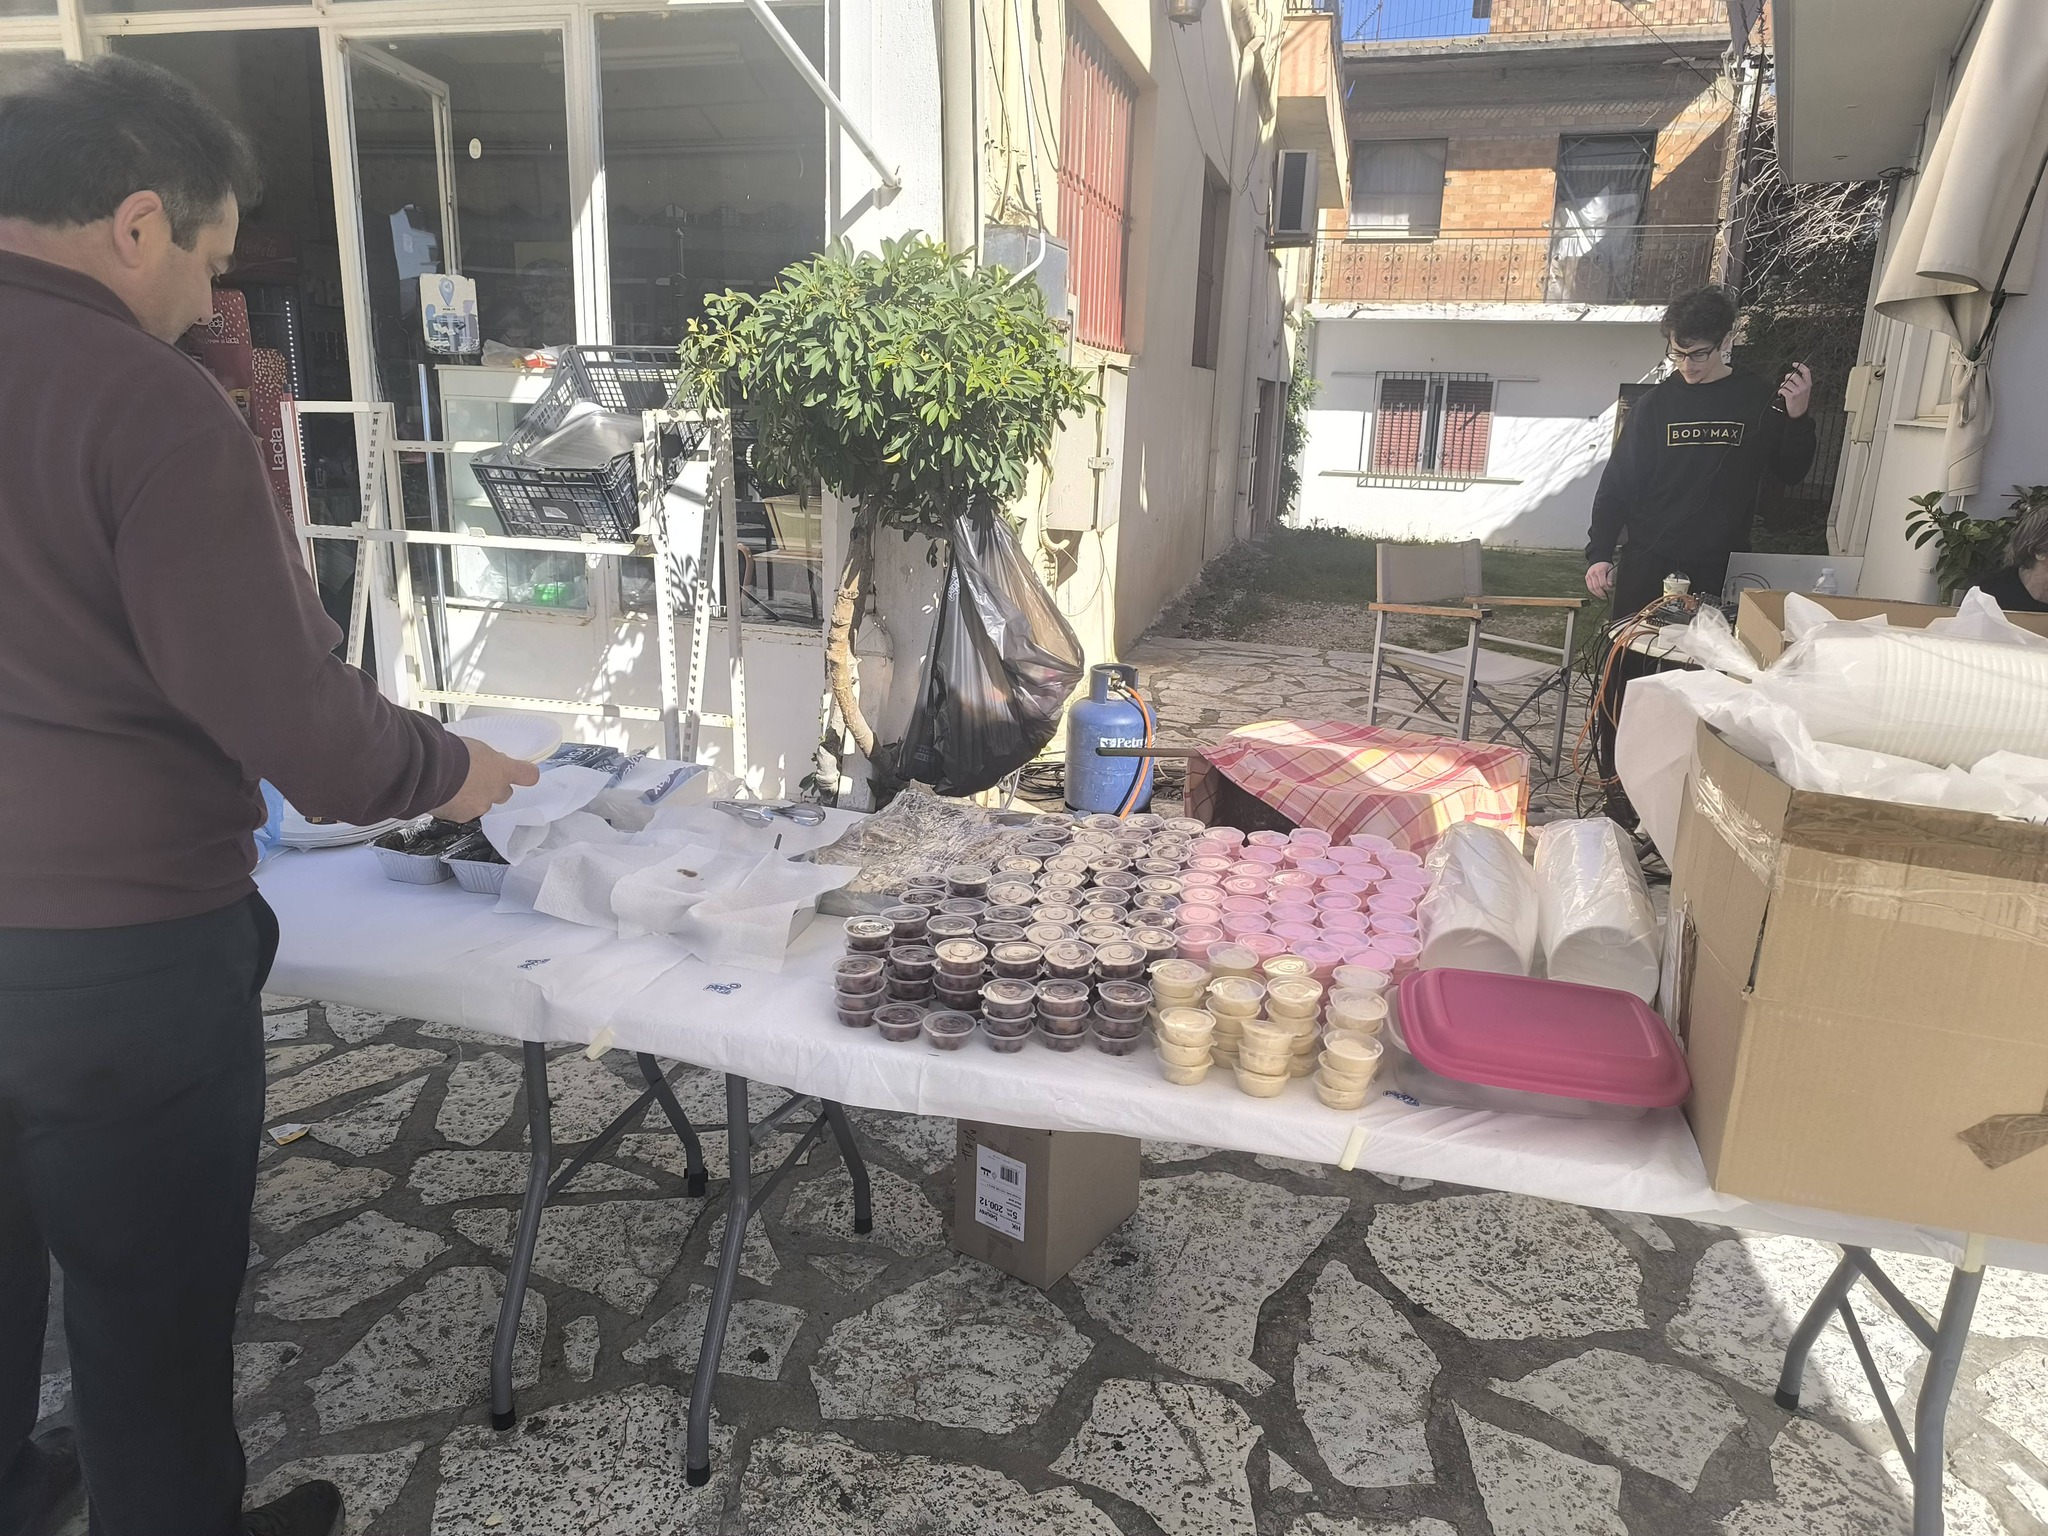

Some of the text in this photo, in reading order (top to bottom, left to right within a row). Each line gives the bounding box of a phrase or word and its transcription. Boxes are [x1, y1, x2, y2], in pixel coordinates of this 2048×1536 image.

[1672, 429, 1738, 439] BODYMAX
[270, 427, 285, 471] lacta
[979, 1196, 1003, 1214] 200.12
[979, 1207, 998, 1222] beurer
[1012, 1211, 1018, 1220] 5
